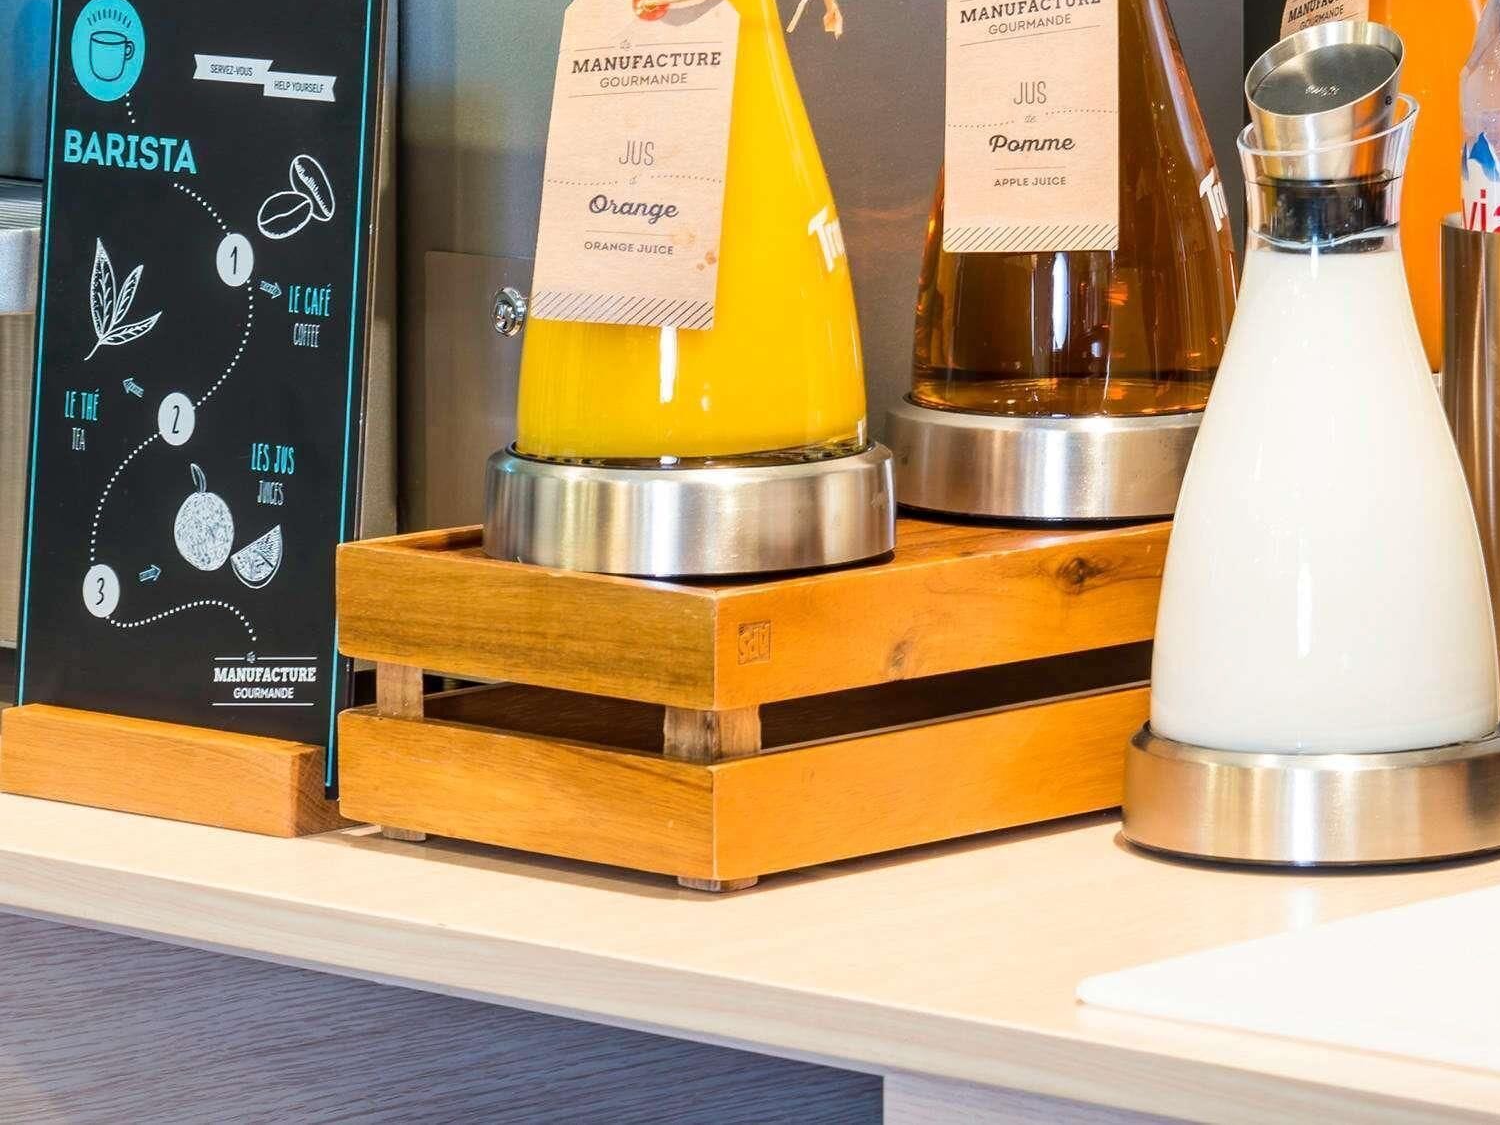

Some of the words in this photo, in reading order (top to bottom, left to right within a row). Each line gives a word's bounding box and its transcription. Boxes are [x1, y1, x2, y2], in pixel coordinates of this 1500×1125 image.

[988, 14, 1072, 35] GOURMANDE
[210, 63, 253, 76] SERVEZ-VOUS
[571, 52, 722, 74] MANUFACTURE
[273, 80, 290, 91] HELP
[291, 82, 325, 94] YOURSELF
[600, 73, 688, 88] GOURMANDE
[1013, 81, 1047, 105] JUS
[64, 129, 198, 175] BARISTA
[618, 140, 655, 166] JUS
[988, 134, 1075, 152] Pomme
[993, 177, 1029, 187] APPLE
[1032, 176, 1067, 186] JUICE
[588, 194, 679, 224] Orange
[230, 245, 238, 275] 1
[584, 241, 634, 252] ORANGE
[637, 243, 674, 255] JUICE
[288, 285, 300, 313] LE
[304, 283, 332, 316] CAFÉ
[293, 322, 320, 347] COFFEE
[64, 390, 77, 418] LE
[80, 388, 100, 420] THÉ
[171, 404, 181, 434] 2
[250, 442, 271, 472] LES
[273, 445, 295, 475] JUS
[96, 577, 105, 606] 3
[213, 667, 317, 683] MANUFACTURE
[233, 687, 295, 699] GOURMANDE
